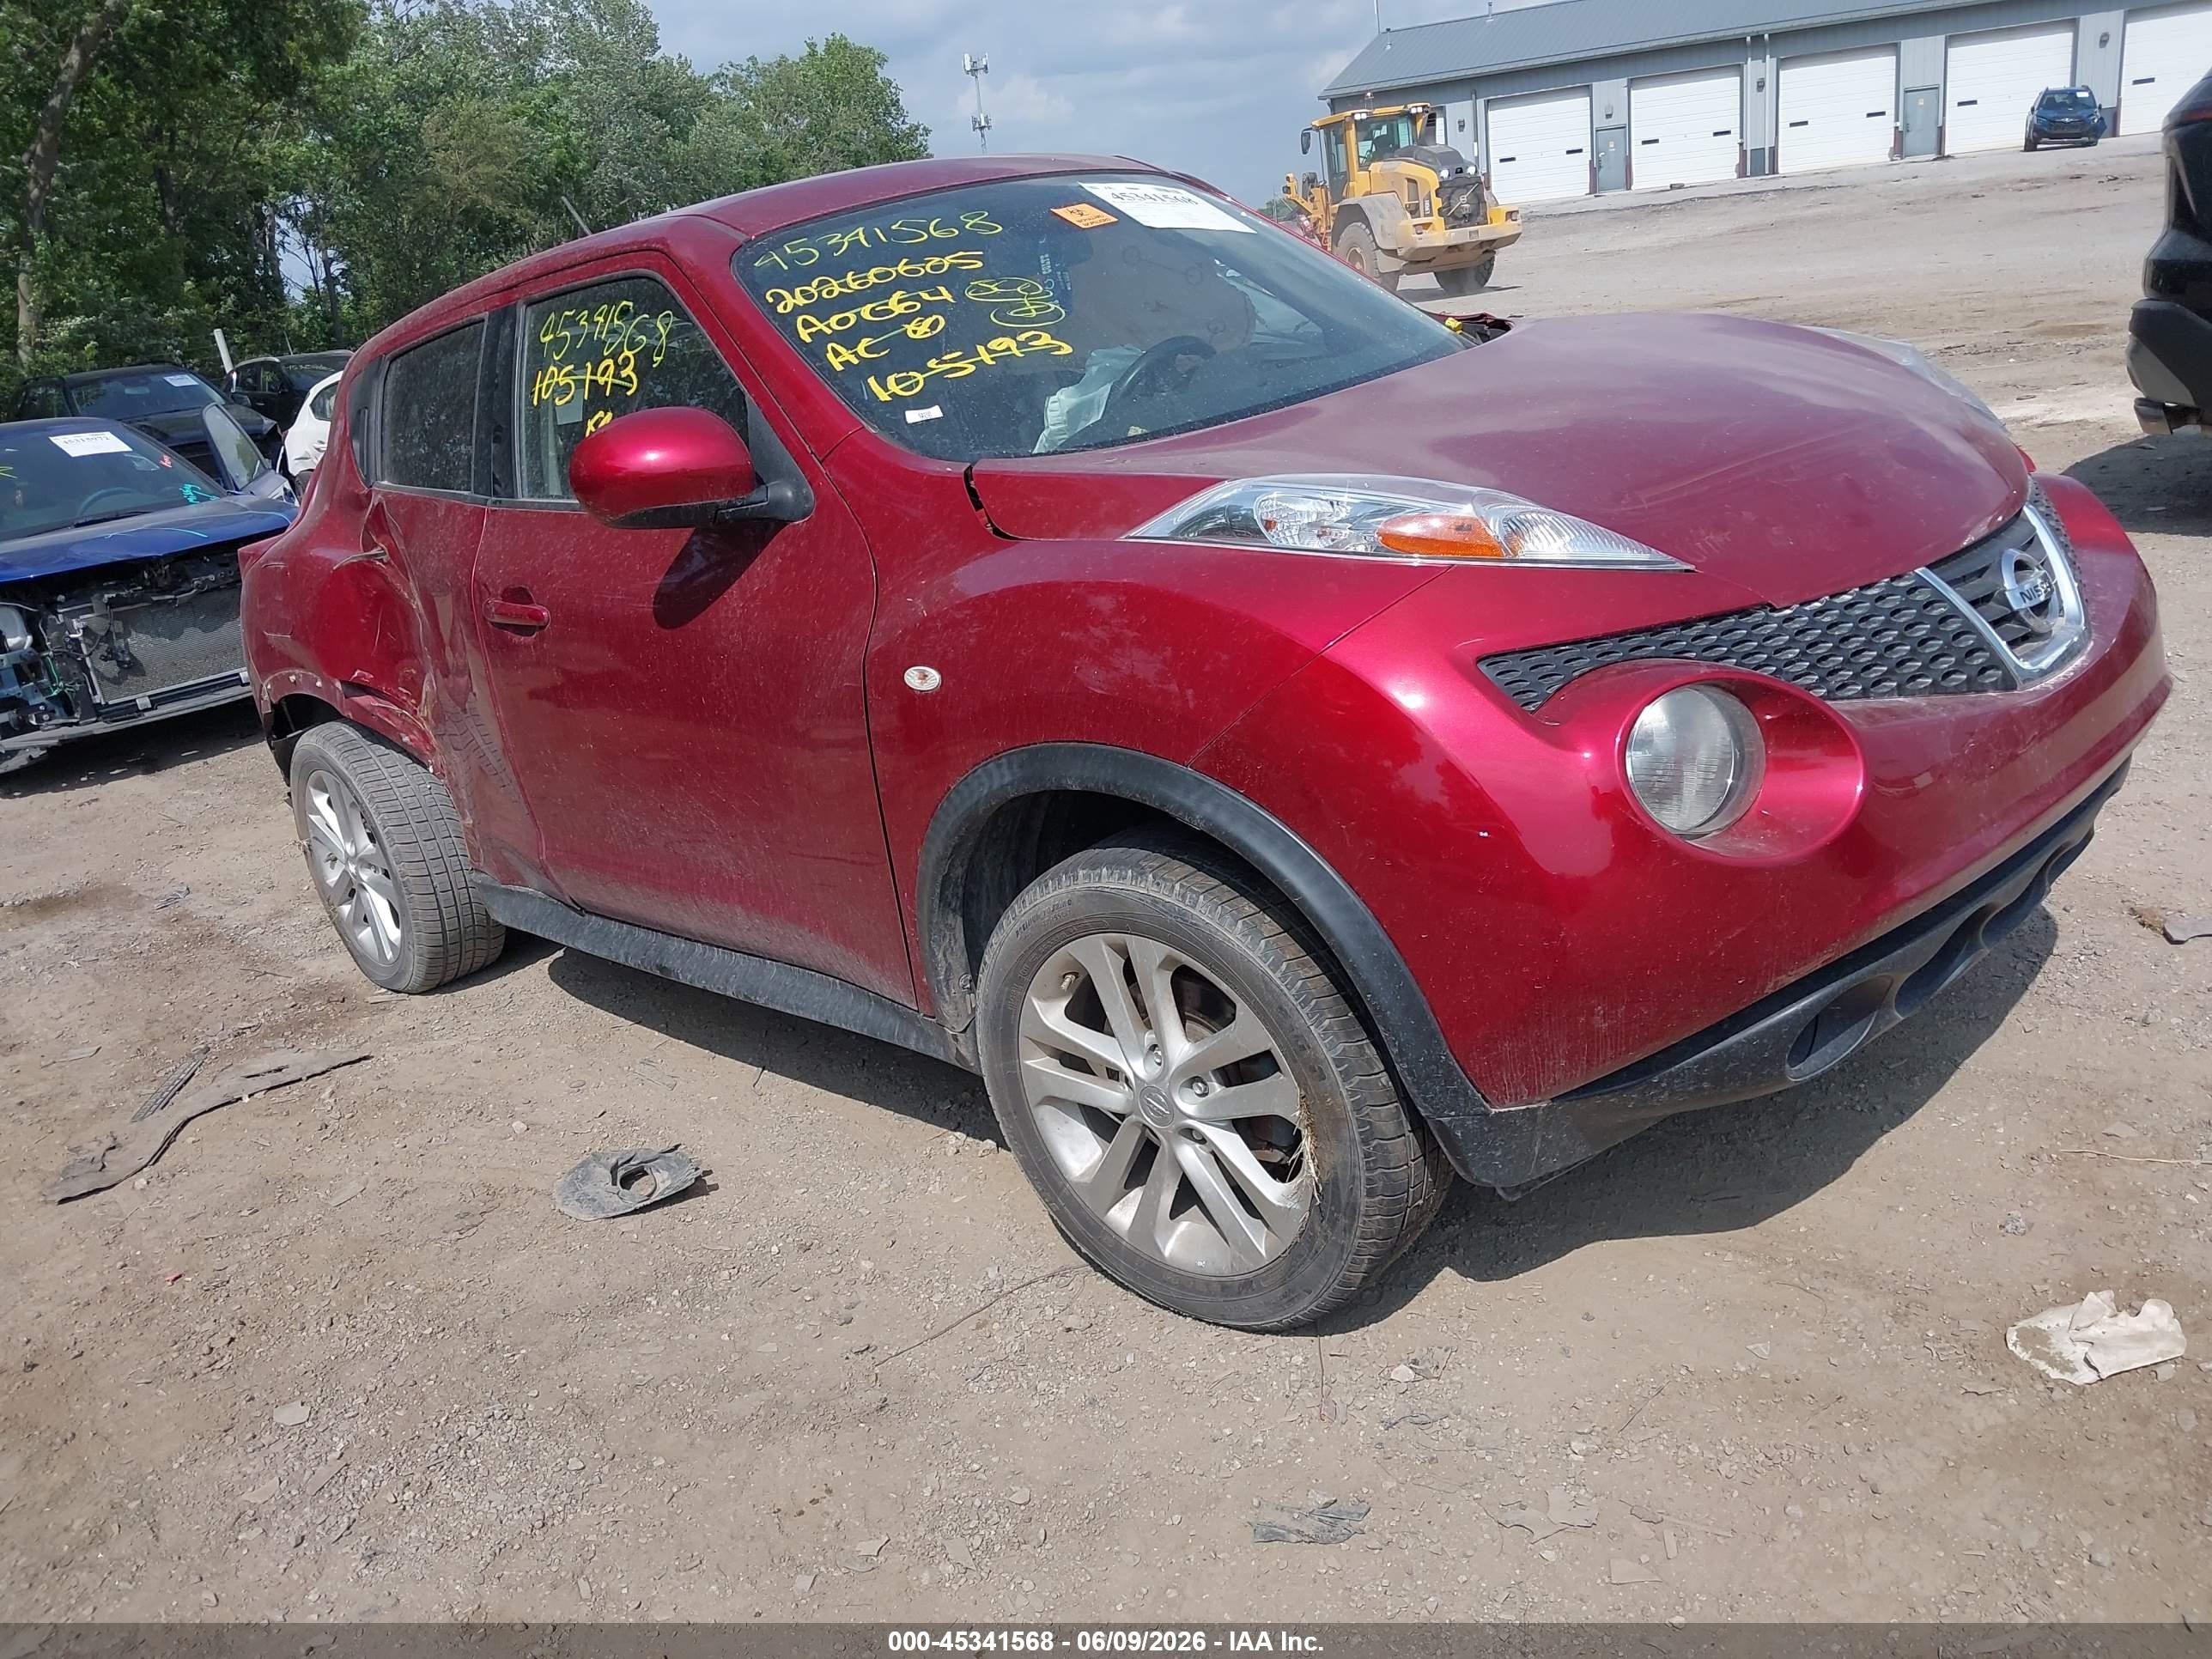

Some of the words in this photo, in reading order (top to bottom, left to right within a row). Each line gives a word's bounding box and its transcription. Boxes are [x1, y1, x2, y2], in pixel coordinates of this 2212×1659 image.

[753, 210, 1003, 270] 45341568
[765, 251, 984, 314] 20260605
[539, 301, 673, 368] 45341568
[531, 349, 638, 406] 105193
[2019, 579, 2052, 604] NIS
